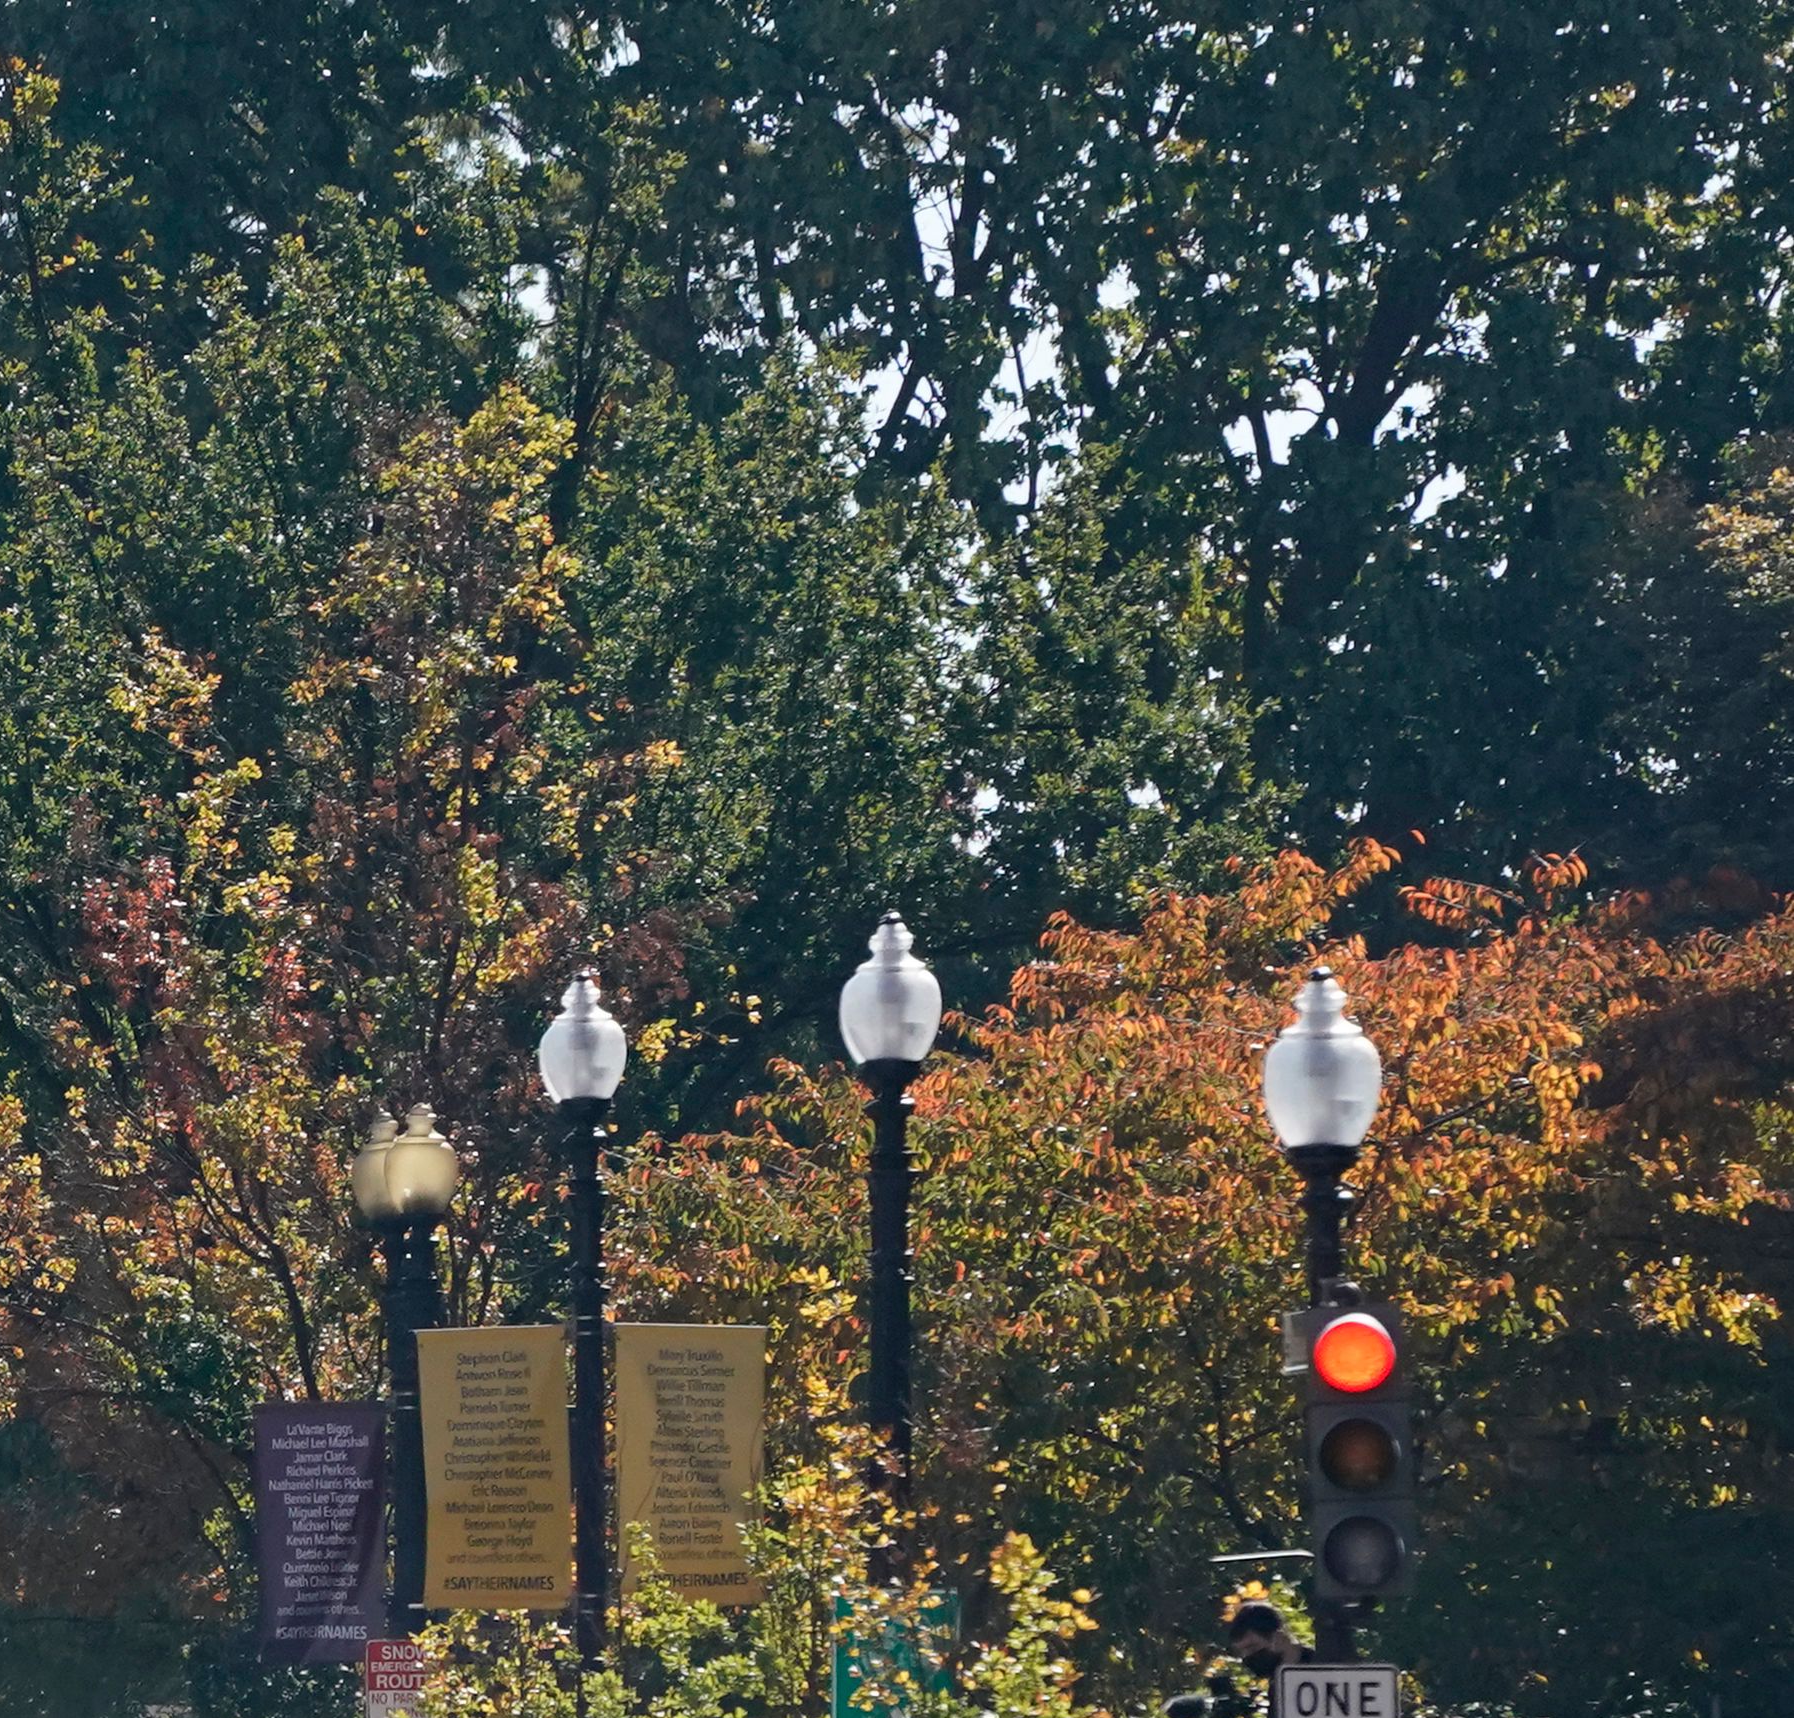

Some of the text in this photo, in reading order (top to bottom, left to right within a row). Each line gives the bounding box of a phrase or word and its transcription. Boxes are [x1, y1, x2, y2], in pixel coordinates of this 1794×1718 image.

[444, 1576, 555, 1591] #SAYTHEIRNAMES
[373, 1692, 388, 1704] NO
[1296, 1681, 1382, 1717] ONE
